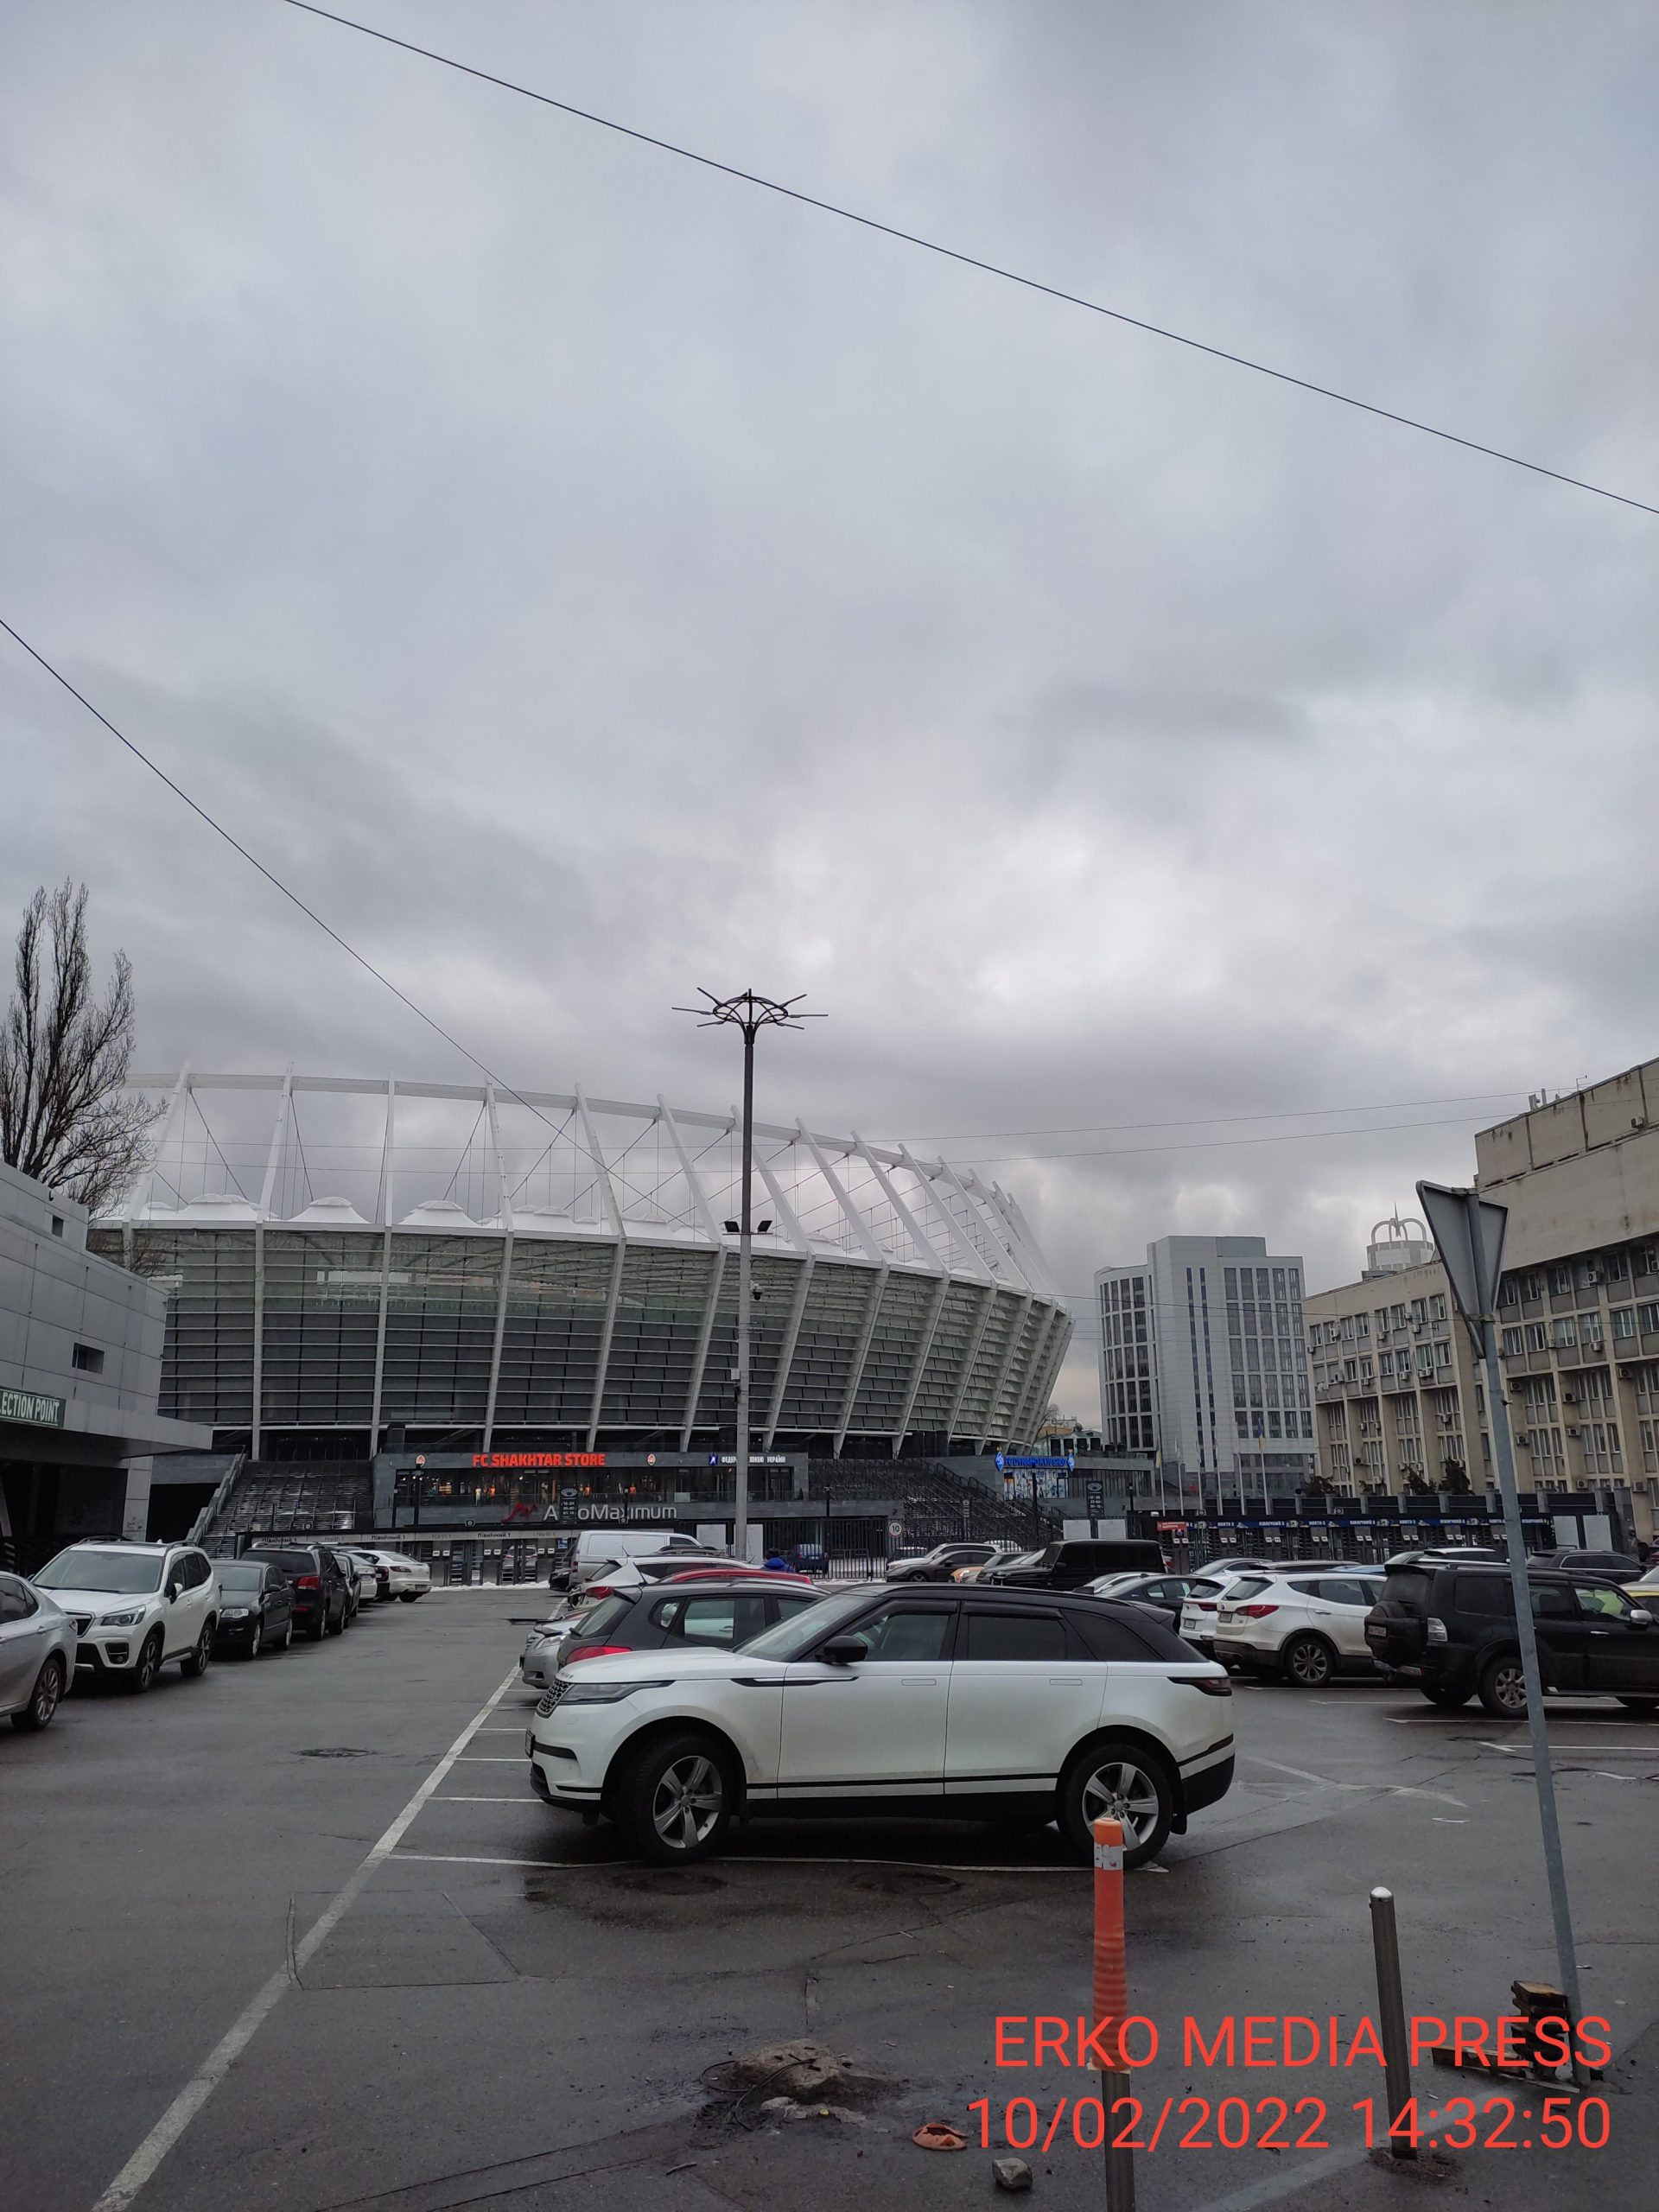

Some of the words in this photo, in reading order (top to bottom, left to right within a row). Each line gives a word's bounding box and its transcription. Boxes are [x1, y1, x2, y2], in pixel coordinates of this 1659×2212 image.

[0, 1391, 35, 1419] ECTION
[35, 1398, 60, 1422] POINT
[473, 1453, 489, 1466] FC
[491, 1453, 562, 1466] SHAKHTAR
[564, 1453, 605, 1466] STORE
[892, 1525, 900, 1534] 10
